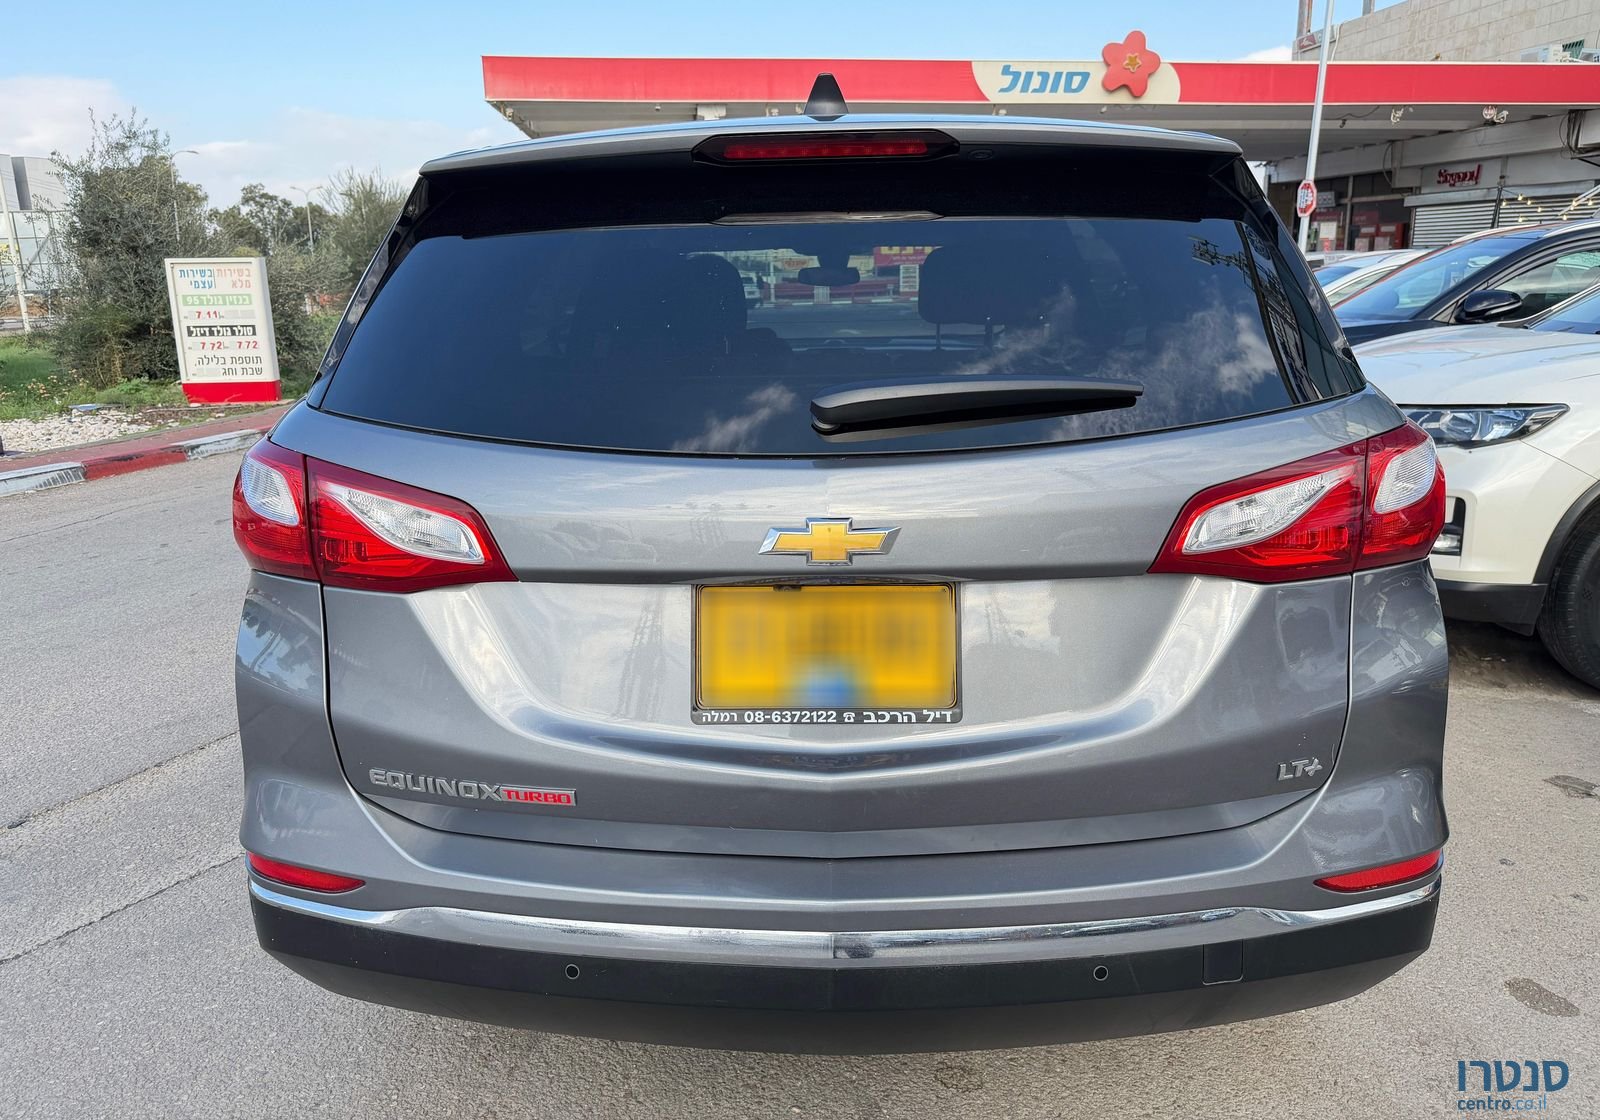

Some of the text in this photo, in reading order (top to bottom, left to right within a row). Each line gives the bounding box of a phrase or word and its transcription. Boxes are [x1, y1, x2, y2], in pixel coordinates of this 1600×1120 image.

[998, 64, 1091, 93] סונול
[179, 268, 213, 278] בשירות
[217, 268, 251, 278] בשירות
[190, 280, 213, 289] עצמי
[232, 279, 251, 289] מלא
[202, 294, 224, 305] גולד
[226, 295, 250, 306] בנזין
[190, 325, 253, 337] סולר גולד דיזל
[230, 356, 262, 365] תוספת
[222, 367, 263, 376] שבת וחג
[702, 709, 952, 723] דיל הרכב 08-6372122 רמלה
[369, 767, 572, 804] EQUINOX TURBO
